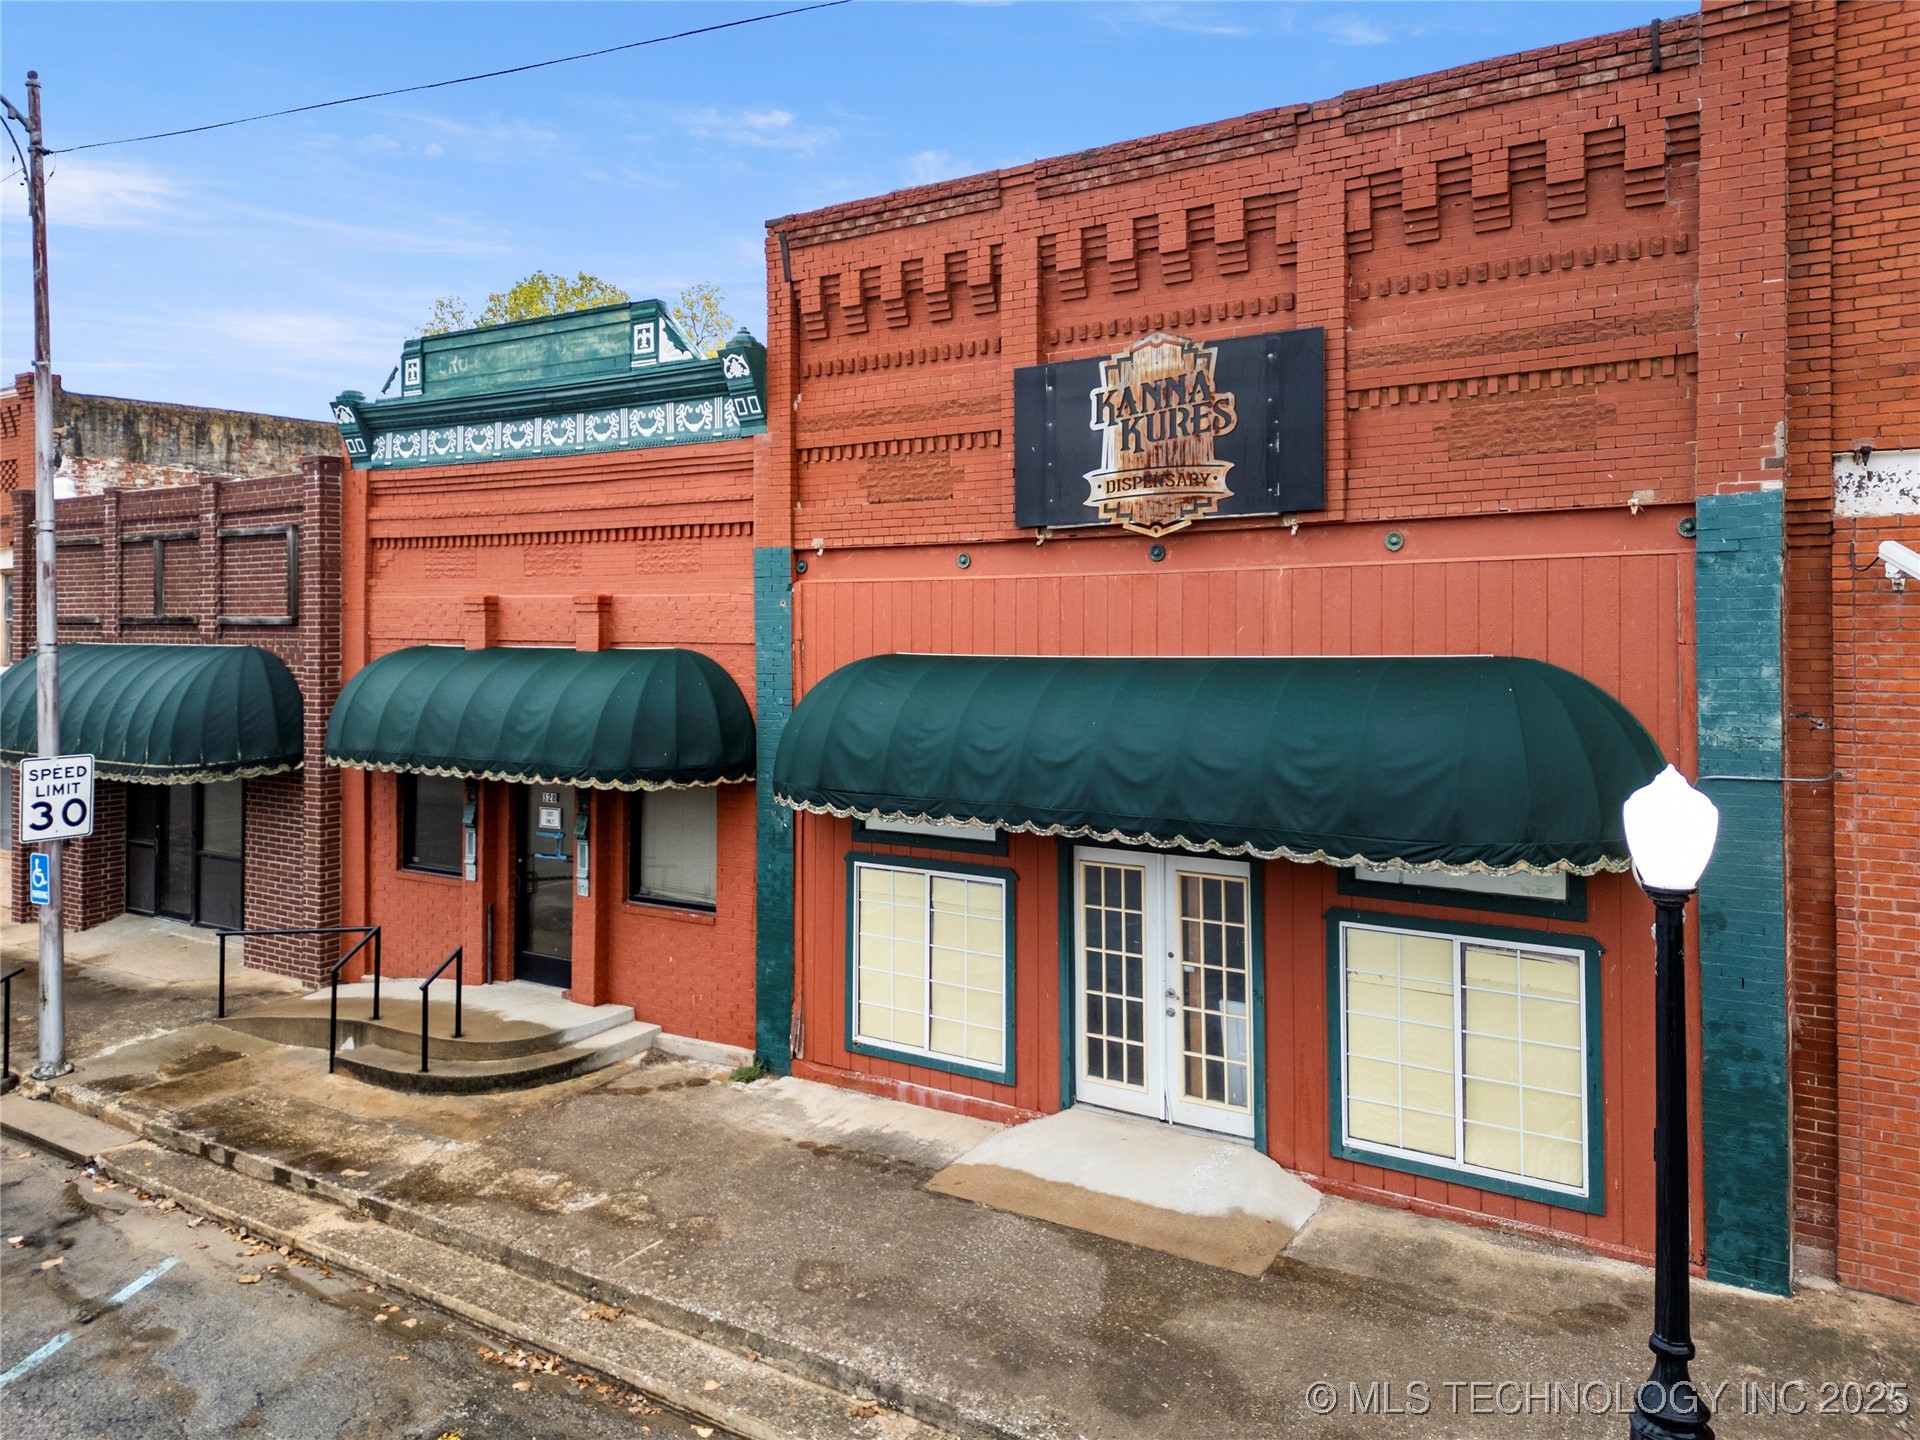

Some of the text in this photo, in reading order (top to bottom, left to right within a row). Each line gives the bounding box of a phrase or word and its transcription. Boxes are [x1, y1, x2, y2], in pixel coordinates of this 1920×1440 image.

[1095, 370, 1211, 427] KANNA
[1120, 398, 1232, 454] KURES
[1106, 472, 1211, 494] DISPENSARY
[28, 765, 87, 782] SPEED
[35, 782, 81, 798] LIMIT
[28, 798, 87, 831] 30
